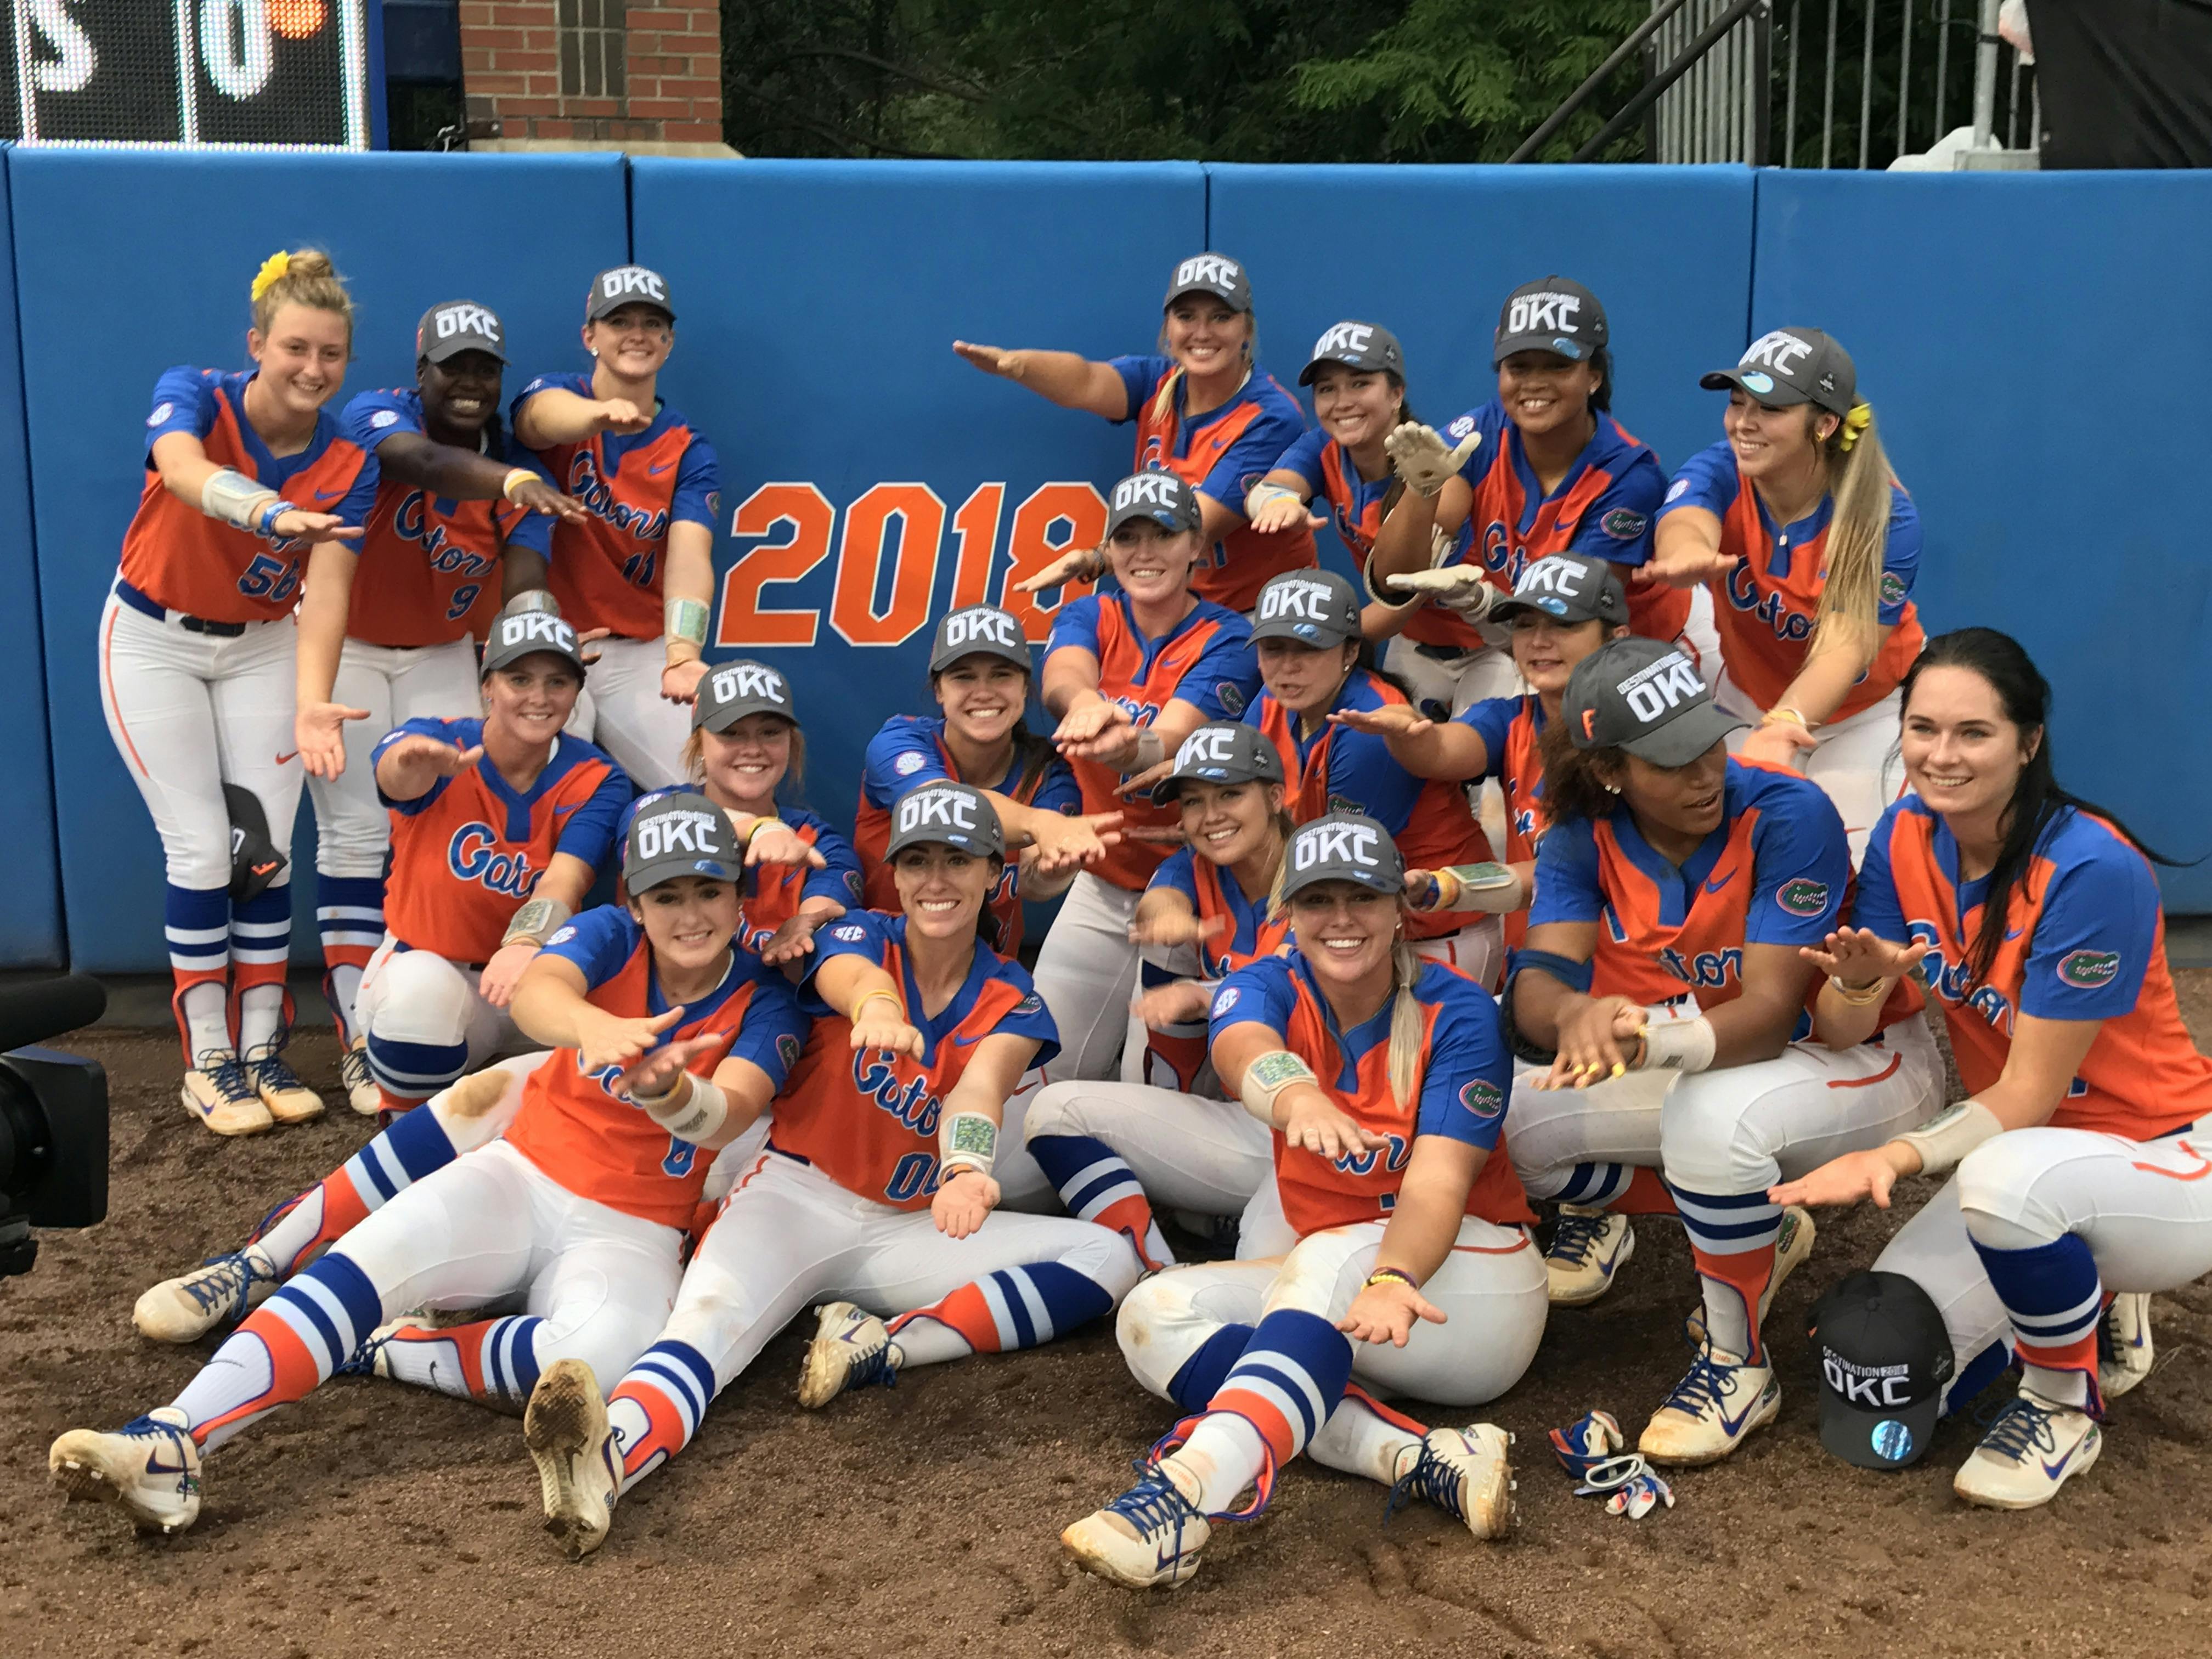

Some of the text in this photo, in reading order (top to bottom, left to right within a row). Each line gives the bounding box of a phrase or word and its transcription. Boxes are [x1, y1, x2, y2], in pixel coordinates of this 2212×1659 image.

[603, 273, 665, 301] OKC
[1178, 259, 1238, 291] OKC
[436, 308, 500, 342] OKC
[1509, 302, 1581, 334] OKC
[1313, 327, 1373, 360] OKC
[1738, 338, 1810, 376] OKC
[1115, 481, 1180, 511] OKC
[236, 552, 301, 602] 56
[622, 549, 656, 587] 11
[715, 481, 1110, 647] 2018
[1514, 563, 1586, 596] OKC
[445, 583, 482, 622] 9
[1261, 588, 1332, 621] OKC
[502, 617, 574, 652] OKC
[947, 614, 1016, 647] OKC
[714, 672, 786, 704] OKC
[1172, 733, 1235, 775] OKC
[900, 798, 977, 833] OKC
[638, 820, 720, 860] OKC
[1295, 833, 1379, 871] OKC
[833, 926, 865, 941] SEC
[1823, 1358, 1912, 1407] OKC
